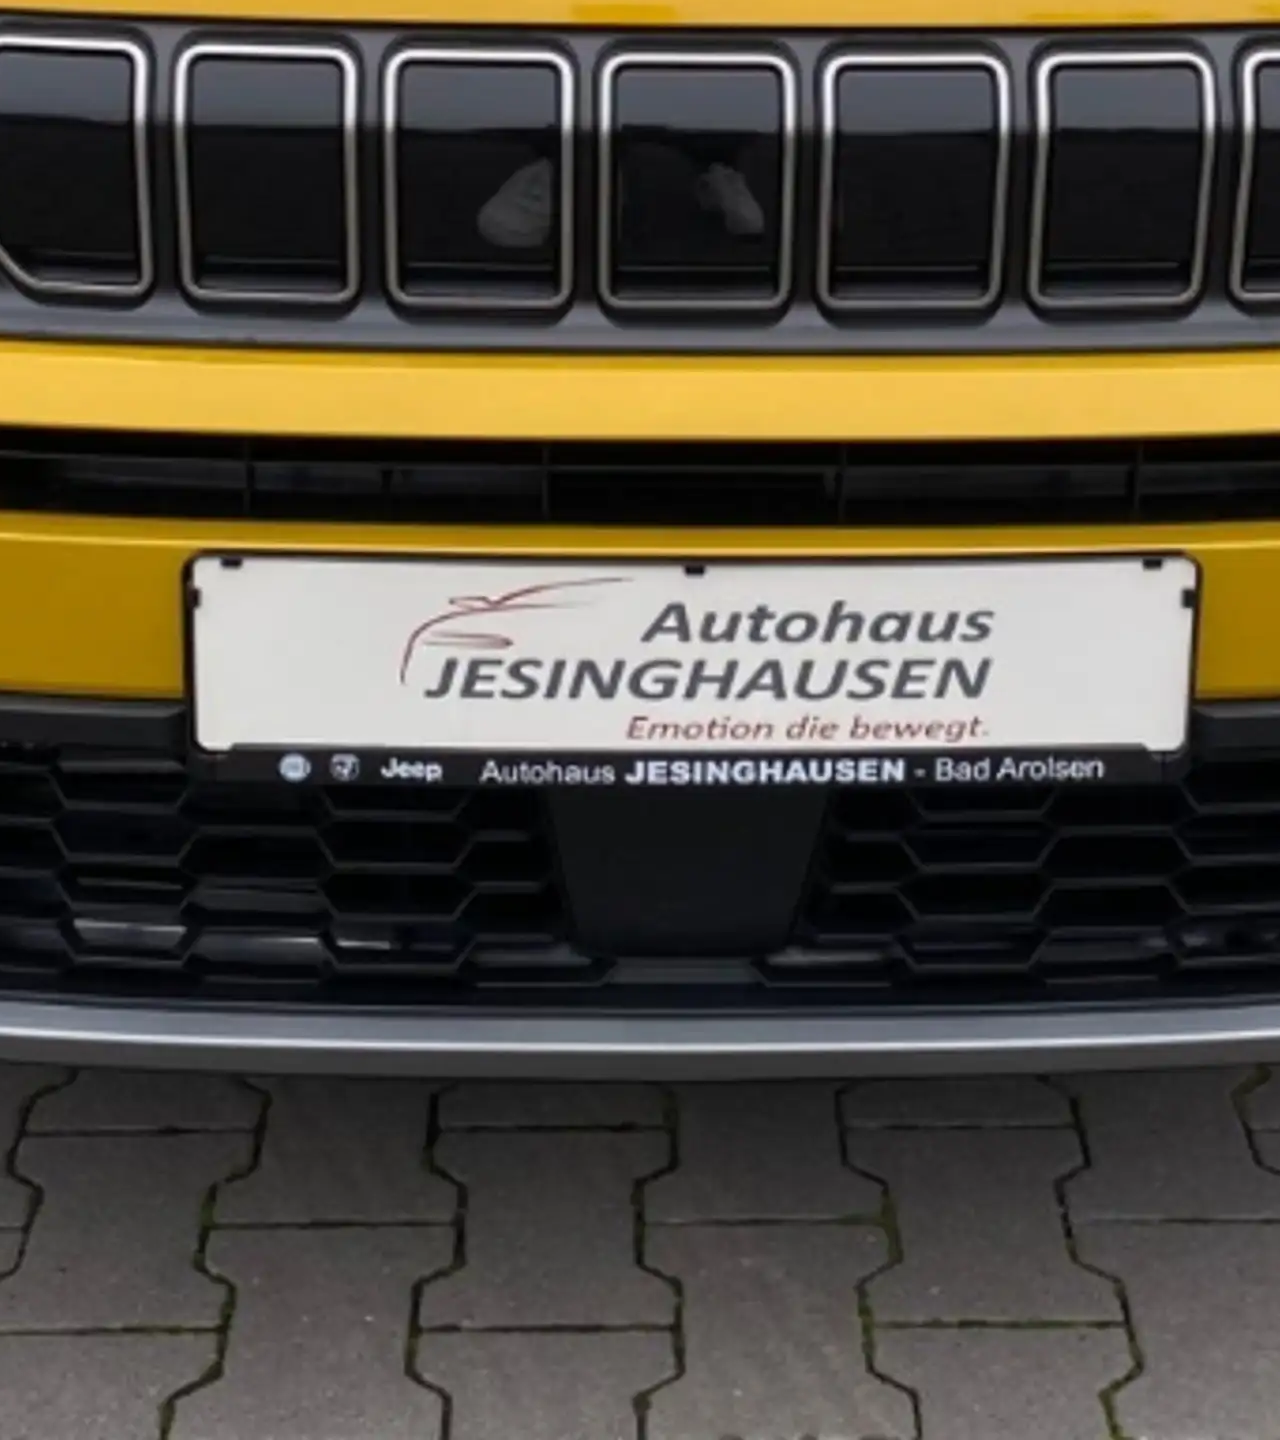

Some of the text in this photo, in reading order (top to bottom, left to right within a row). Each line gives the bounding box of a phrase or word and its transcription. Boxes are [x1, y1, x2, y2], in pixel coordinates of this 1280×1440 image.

[641, 600, 995, 643] Autohaus
[425, 657, 995, 701] JESINGHAUSEN
[626, 715, 990, 743] Emotion die bewegt.
[380, 756, 443, 783] Jeep
[478, 758, 616, 785] Autohaus
[624, 758, 906, 785] JESINGHAUSEN
[935, 757, 990, 783] Bad
[996, 756, 1104, 782] Arolsen
